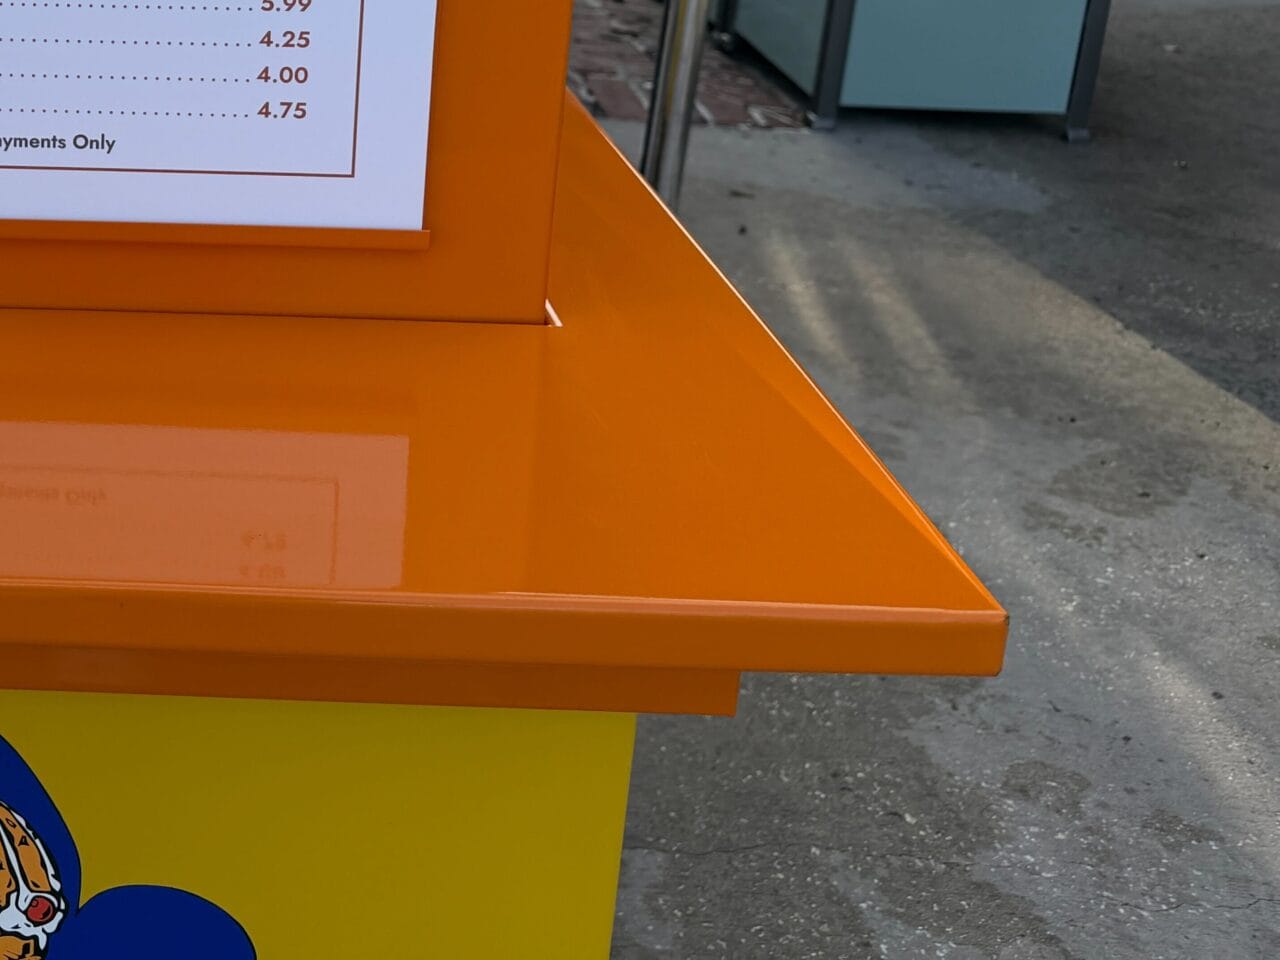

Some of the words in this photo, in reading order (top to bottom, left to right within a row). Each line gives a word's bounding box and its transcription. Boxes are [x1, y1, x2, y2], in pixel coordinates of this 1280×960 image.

[258, 31, 310, 48] 4.25
[255, 66, 308, 83] 4.00
[256, 102, 306, 119] 4.75
[72, 134, 115, 154] Only
